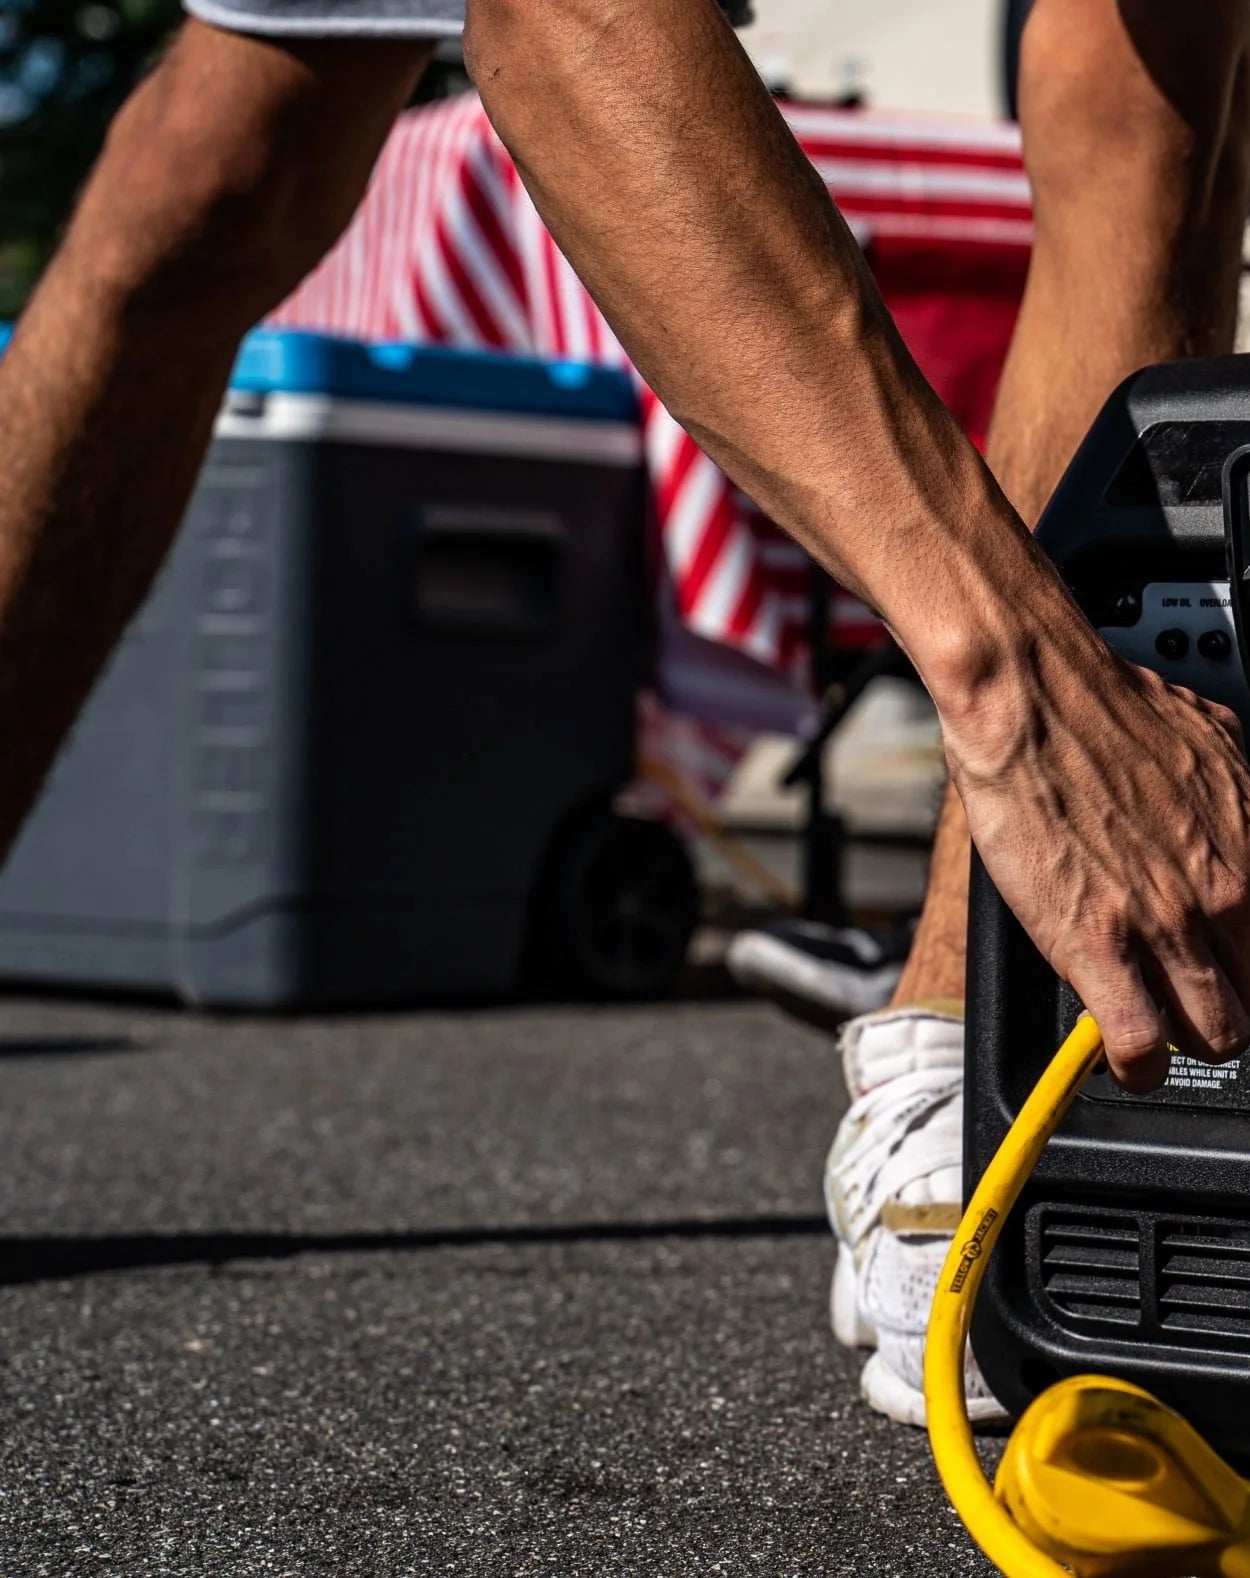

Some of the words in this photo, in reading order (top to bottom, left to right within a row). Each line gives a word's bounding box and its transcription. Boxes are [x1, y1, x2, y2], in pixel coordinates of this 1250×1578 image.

[1161, 597, 1178, 607] LOW
[1180, 597, 1192, 607] OIL
[1200, 598, 1232, 608] OVERLOA
[1168, 1066, 1188, 1076] ABLES
[1189, 1068, 1211, 1077] WHILE
[1212, 1069, 1228, 1079] UNIT
[1229, 1070, 1237, 1079] IS
[1170, 1077, 1191, 1087] AVOID
[1192, 1079, 1223, 1089] DAMAGE.
